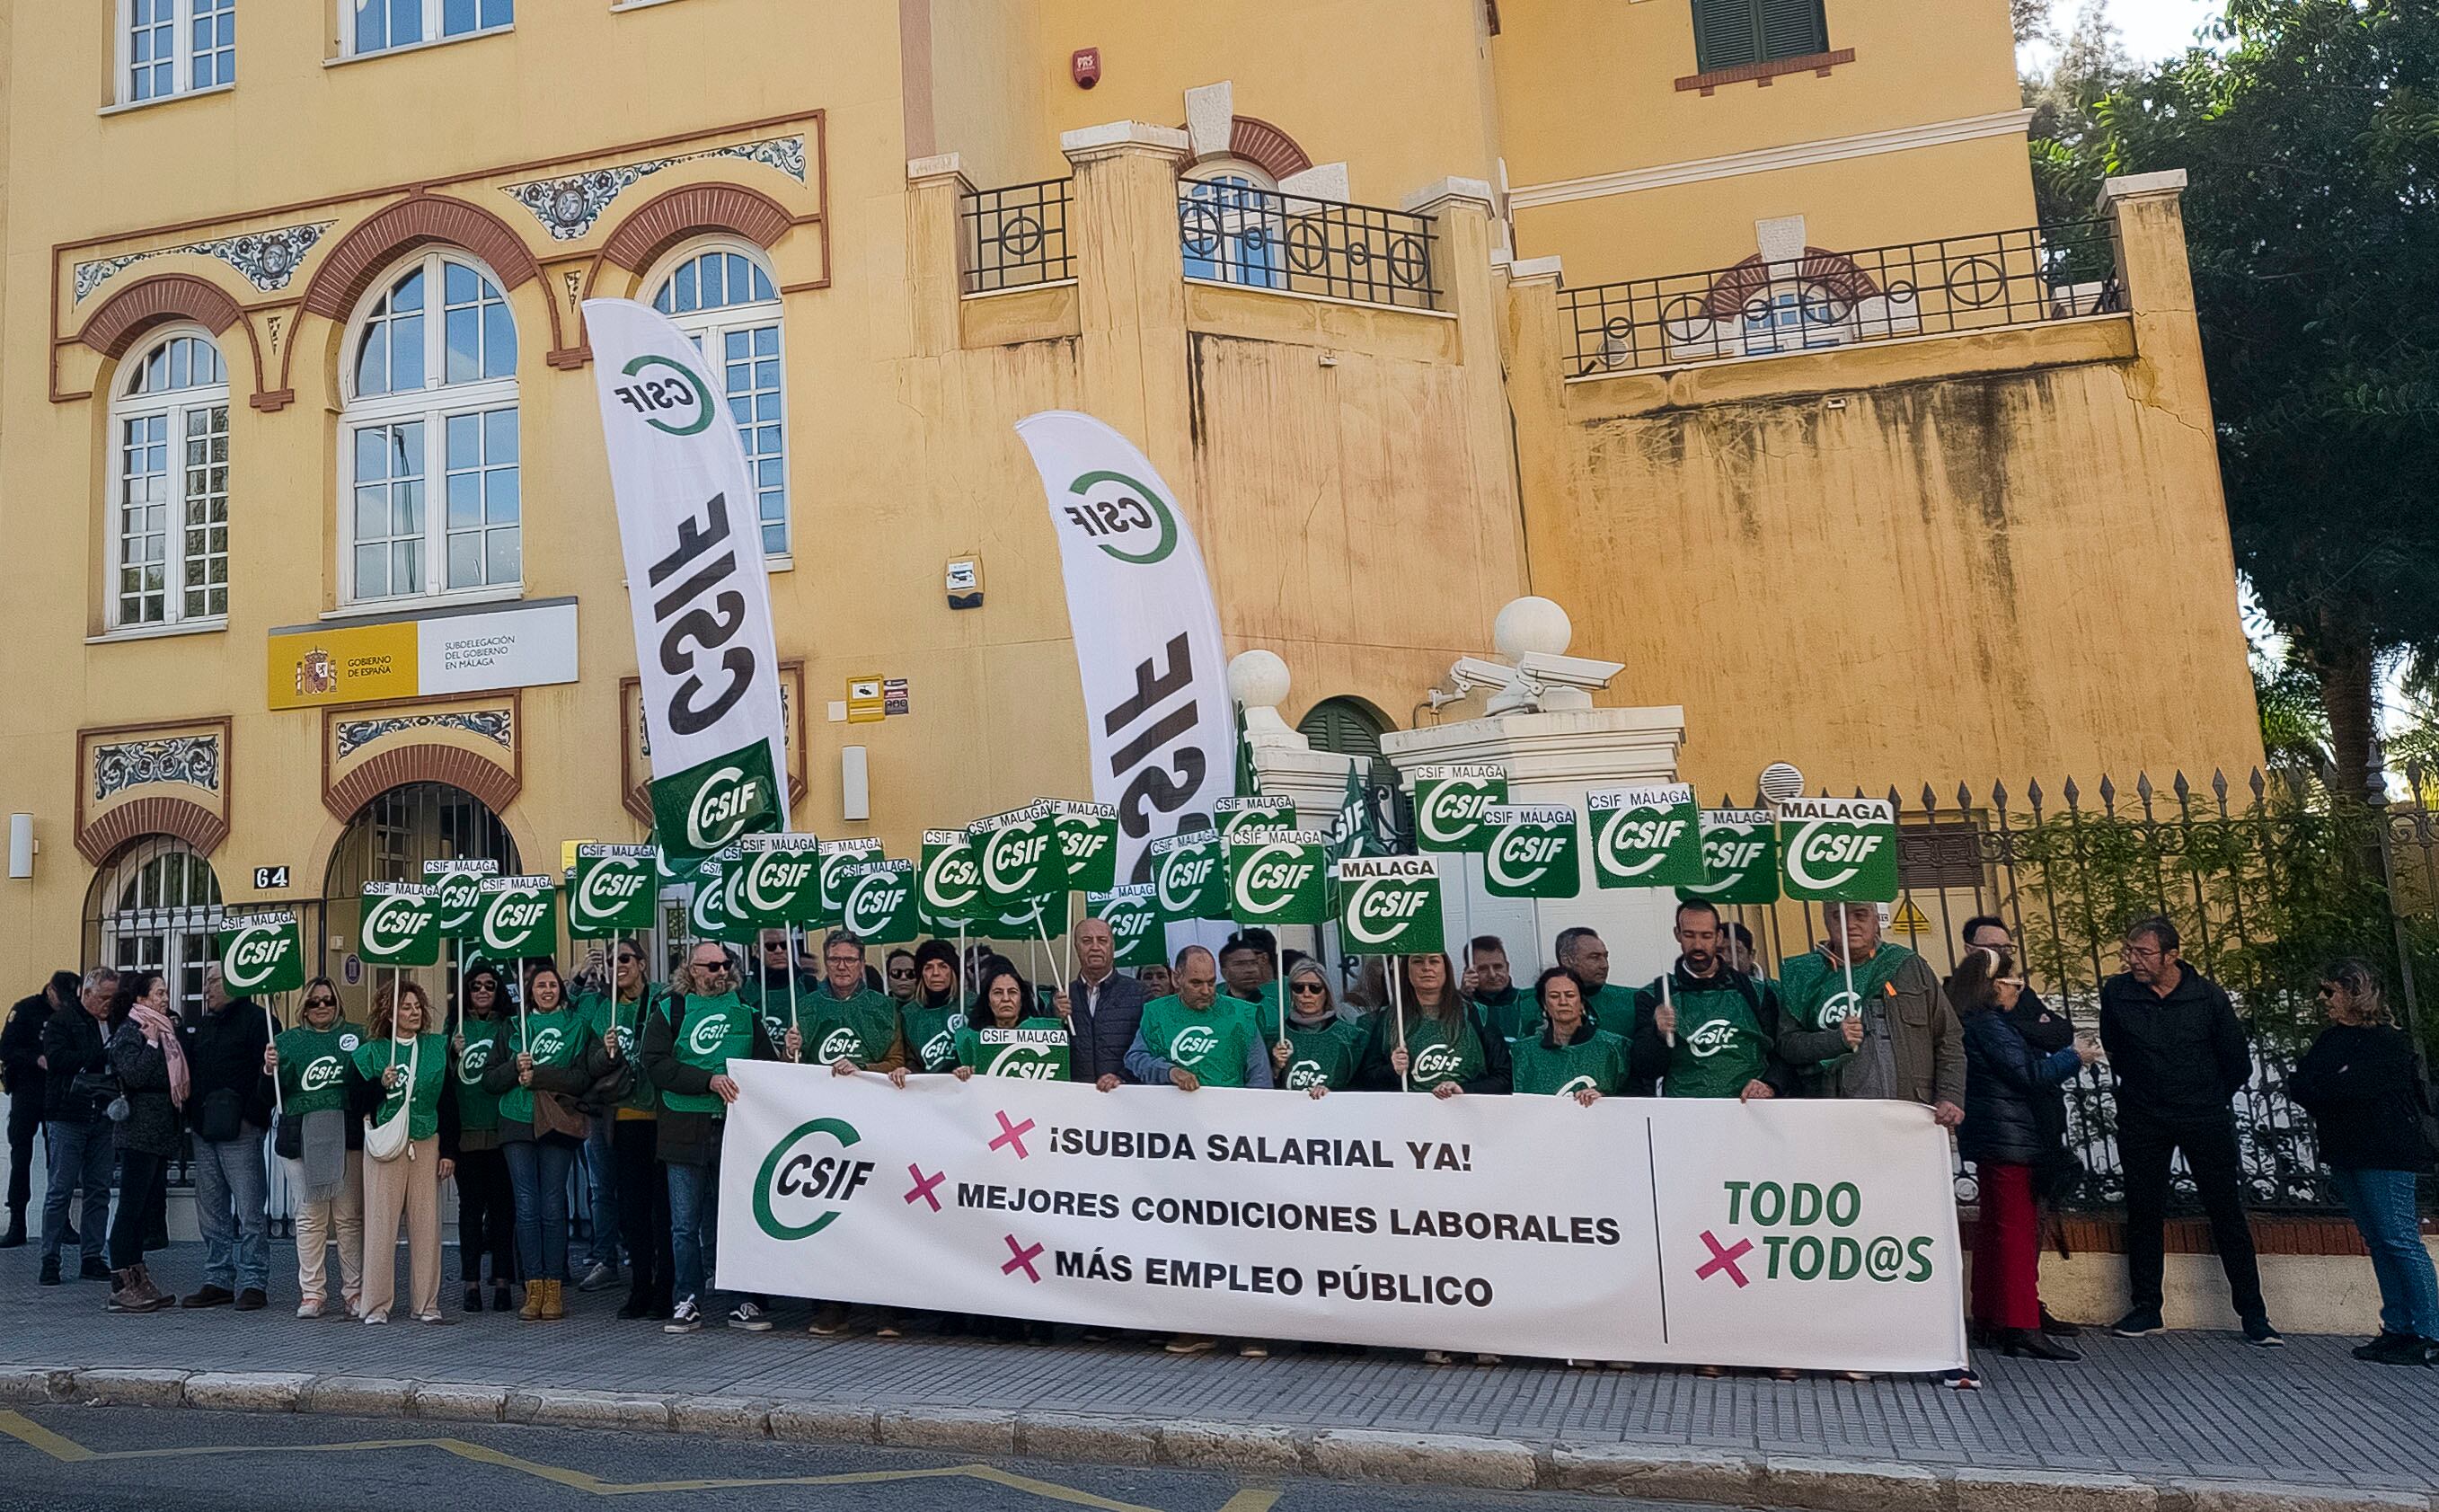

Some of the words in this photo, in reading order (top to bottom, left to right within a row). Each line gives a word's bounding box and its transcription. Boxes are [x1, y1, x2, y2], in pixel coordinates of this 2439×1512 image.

[445, 635, 516, 650] SUBDELEGACIÓN
[347, 655, 392, 668] GOBIERNO
[445, 650, 460, 660] DEL
[462, 646, 508, 659] GOBIERNO
[348, 669, 359, 677] DE
[360, 664, 392, 676] ESPAÑA
[445, 661, 456, 670] EN
[458, 657, 495, 669] MÁLAGA
[1417, 767, 1445, 778] CSIF
[700, 780, 756, 827] CSIF
[1215, 800, 1242, 810] CSIF
[1436, 794, 1498, 819] CSIF
[1589, 794, 1621, 809] CSIF
[1630, 789, 1690, 806] MÁLAGA
[1484, 811, 1513, 823] CSIF
[1520, 809, 1574, 823] MÁLAGA
[968, 818, 994, 836] CSIF
[1615, 819, 1686, 849] CSIF
[742, 839, 765, 851] CSIF
[772, 836, 816, 851] MÁLAGA
[925, 832, 952, 844] CSIF
[1153, 840, 1172, 854] CSIF
[1233, 832, 1261, 844] CSIF
[1806, 833, 1883, 862] CSIF
[581, 845, 606, 856] CSIF
[995, 835, 1048, 871] CSIF
[1503, 836, 1567, 862] CSIF
[425, 862, 449, 872] CSIF
[759, 863, 811, 888] CSIF
[841, 865, 864, 878] CSIF
[939, 860, 982, 885] CSI
[1169, 859, 1215, 889] CSIF
[1250, 863, 1313, 889] CSIF
[256, 867, 288, 889] 64
[364, 882, 389, 894] CSIF
[482, 880, 506, 891] CSIF
[592, 873, 647, 897] CSIF
[441, 886, 479, 907] CSI
[1118, 884, 1155, 897] MALAG
[857, 889, 906, 915] CSIF
[1364, 891, 1429, 917] CSIF
[221, 916, 244, 930] CSIF
[376, 910, 433, 934] CSIF
[496, 903, 547, 928] CSIF
[1108, 912, 1154, 936] CSIF
[237, 939, 291, 966] CSIF
[699, 1023, 731, 1040] CSIF
[982, 1030, 1009, 1042] CSIF
[535, 1039, 564, 1054] CSIF
[1179, 1036, 1219, 1054] CSIF
[465, 1052, 487, 1069] CS
[1049, 1126, 1197, 1161] ¡SUBIDA
[1206, 1135, 1394, 1168] SALARIAL
[1405, 1140, 1472, 1172] YA!
[776, 1154, 875, 1202] CSIF
[1723, 1180, 1861, 1227] TODO
[957, 1182, 1120, 1220] MEJORES
[1132, 1196, 1377, 1235] CONDICIONES
[1390, 1207, 1621, 1246] LABORALES
[1761, 1234, 1935, 1284] TOD@S
[1055, 1246, 1133, 1283] MÁS
[1145, 1258, 1303, 1297] EMPLEO
[1317, 1264, 1494, 1308] PÚBLICO
